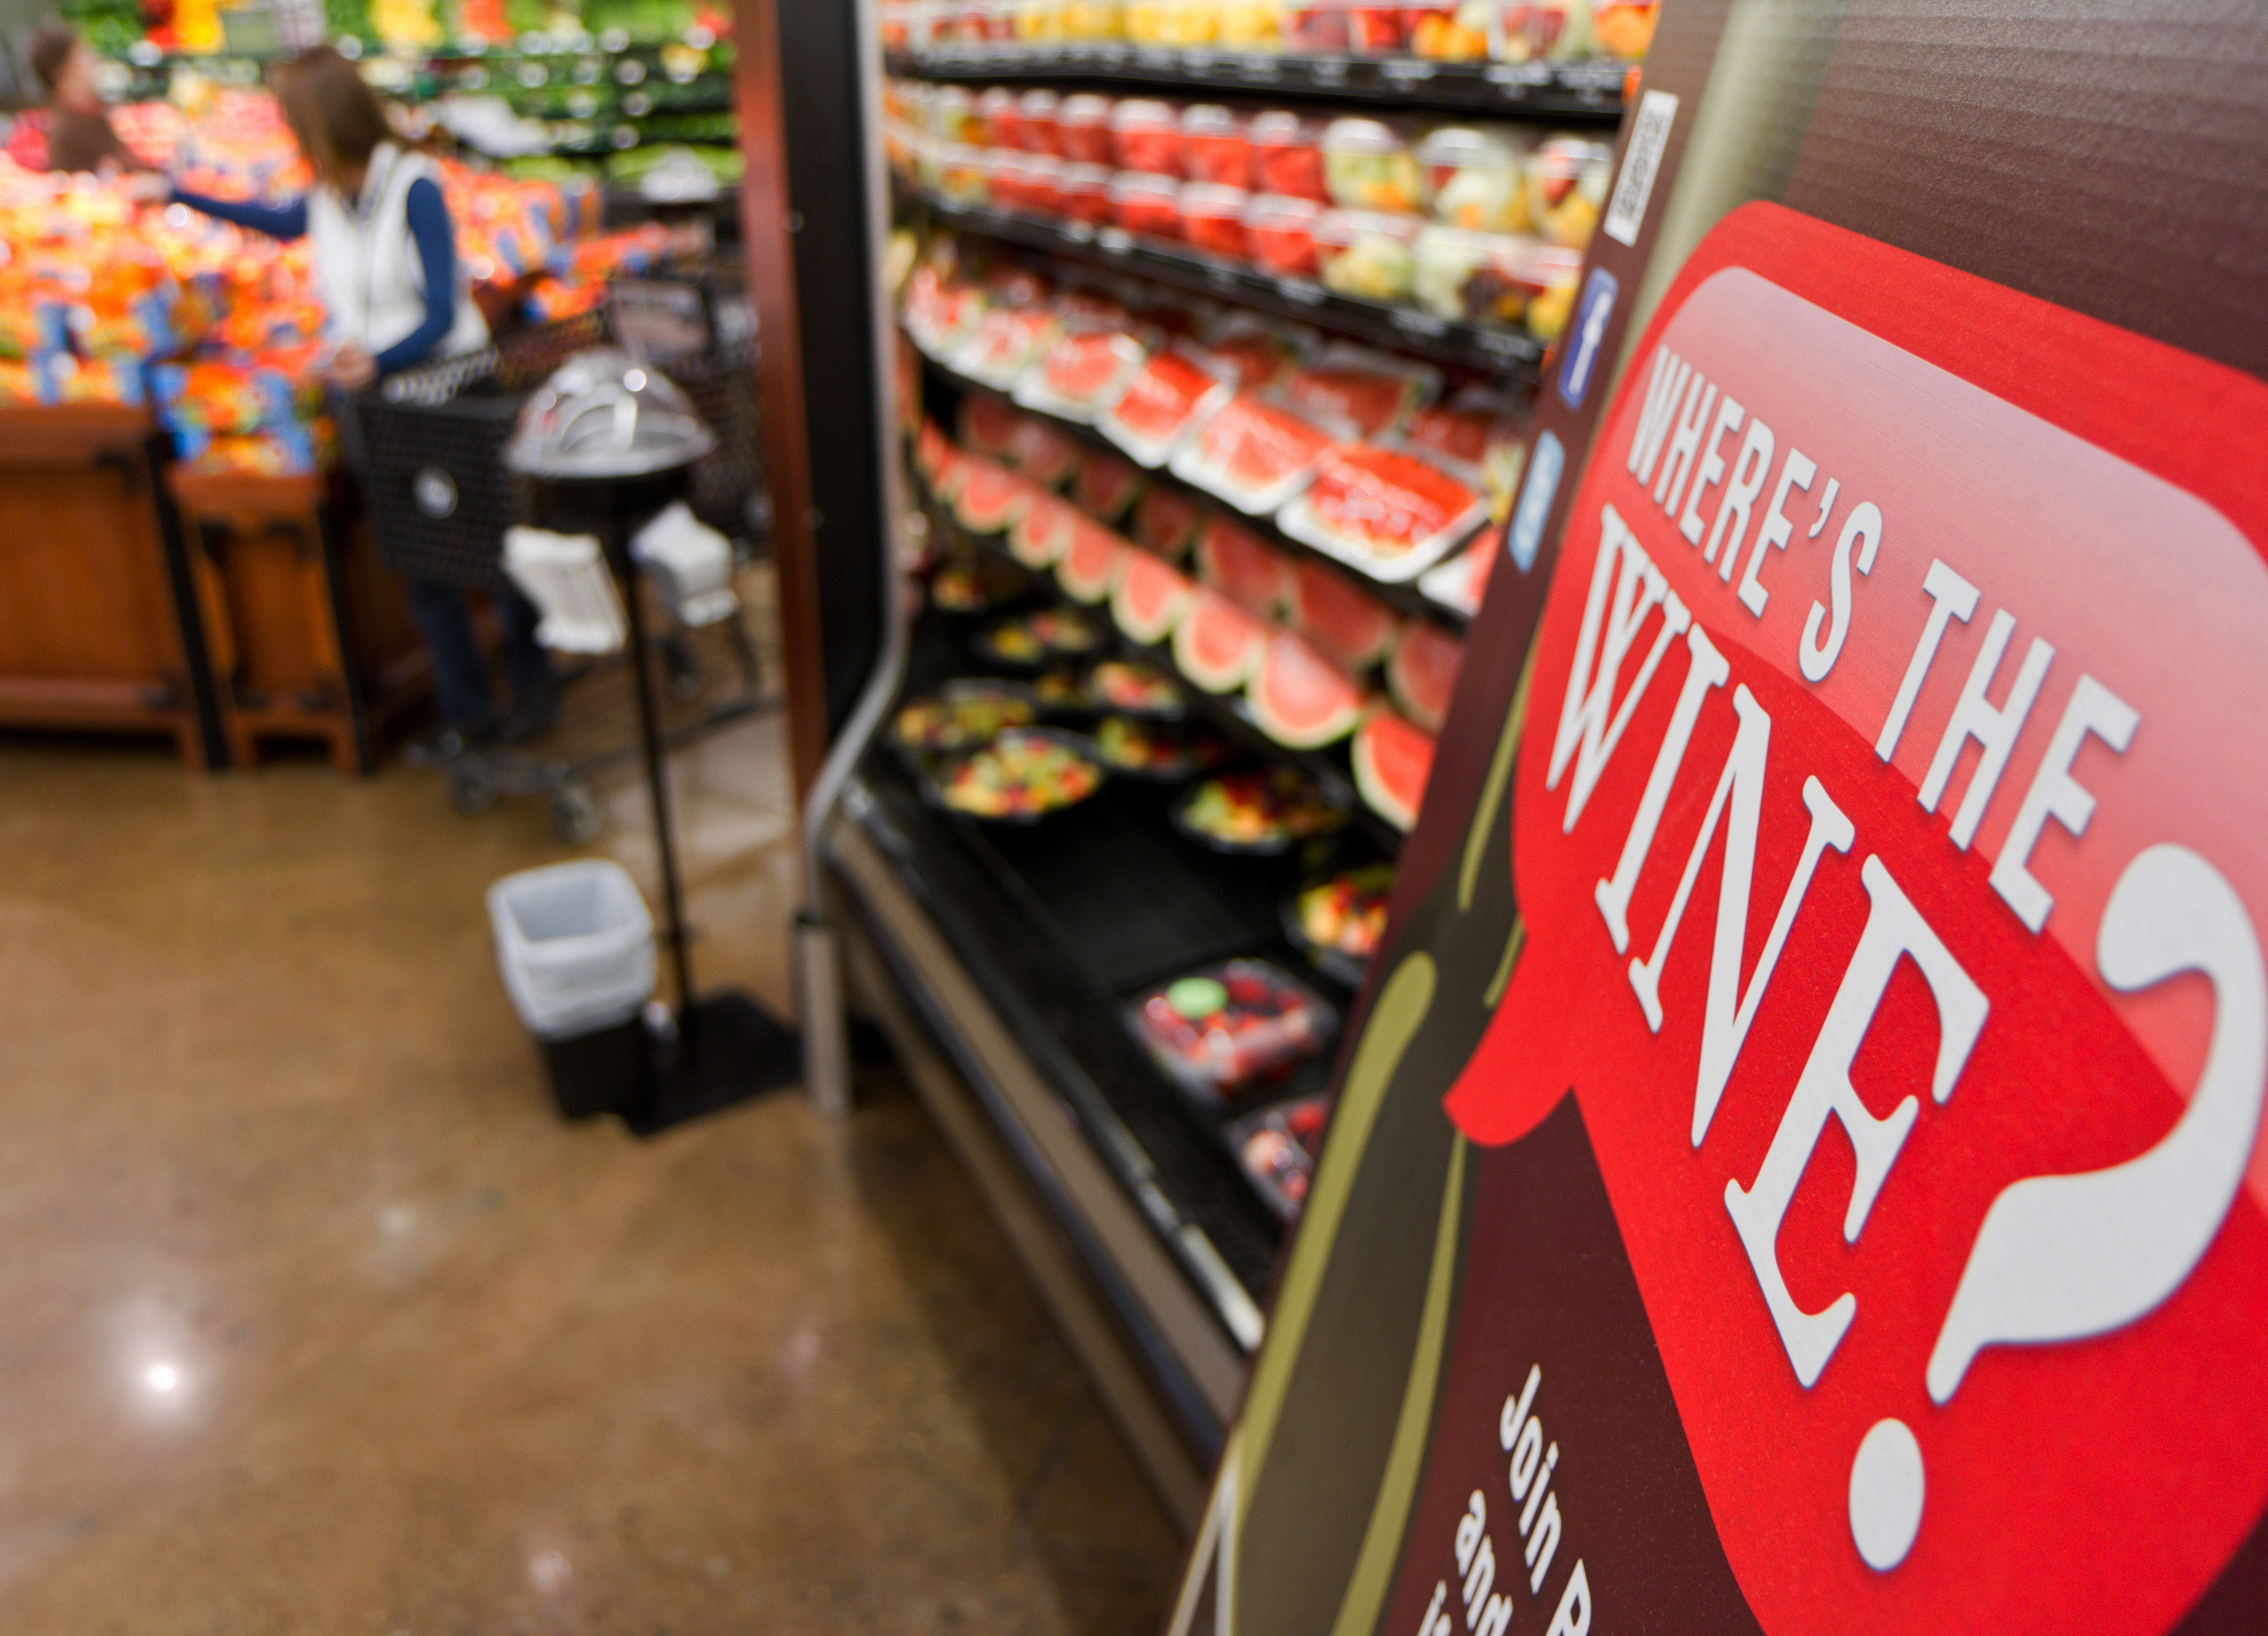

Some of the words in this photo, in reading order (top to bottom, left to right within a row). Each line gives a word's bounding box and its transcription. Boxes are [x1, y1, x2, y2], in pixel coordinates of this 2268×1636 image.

[1626, 342, 1883, 683] WHERE'S
[1873, 557, 2142, 934] THE
[1545, 502, 2268, 1571] WINE?
[1500, 1362, 1561, 1595] Join
